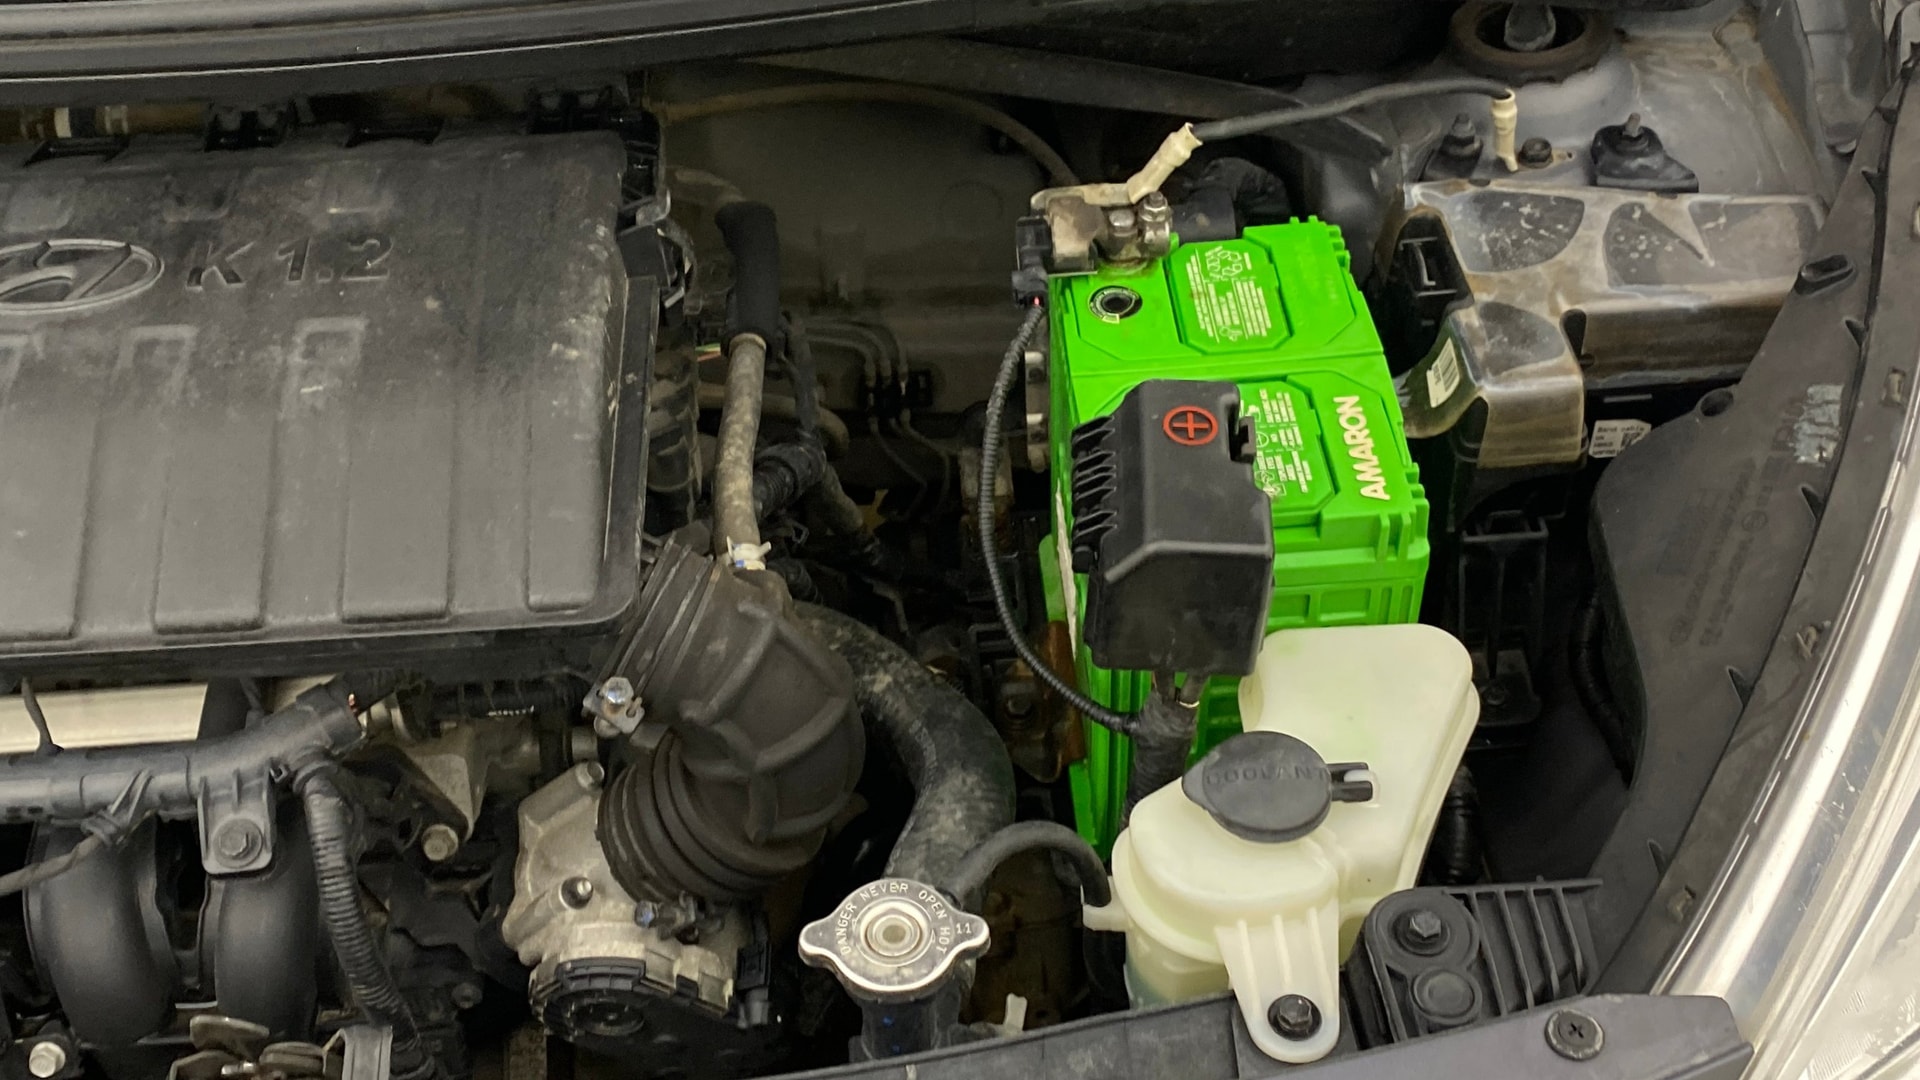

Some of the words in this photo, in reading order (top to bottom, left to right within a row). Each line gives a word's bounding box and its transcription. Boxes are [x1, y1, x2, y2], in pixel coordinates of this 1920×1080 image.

[184, 241, 255, 292] K
[275, 235, 394, 286] 1.2
[1333, 395, 1391, 501] AMARON
[1206, 765, 1328, 785] COOLANT
[835, 902, 858, 955] DANGER
[860, 882, 909, 901] NEVER
[918, 890, 948, 920] OPEN
[937, 926, 951, 955] HOT
